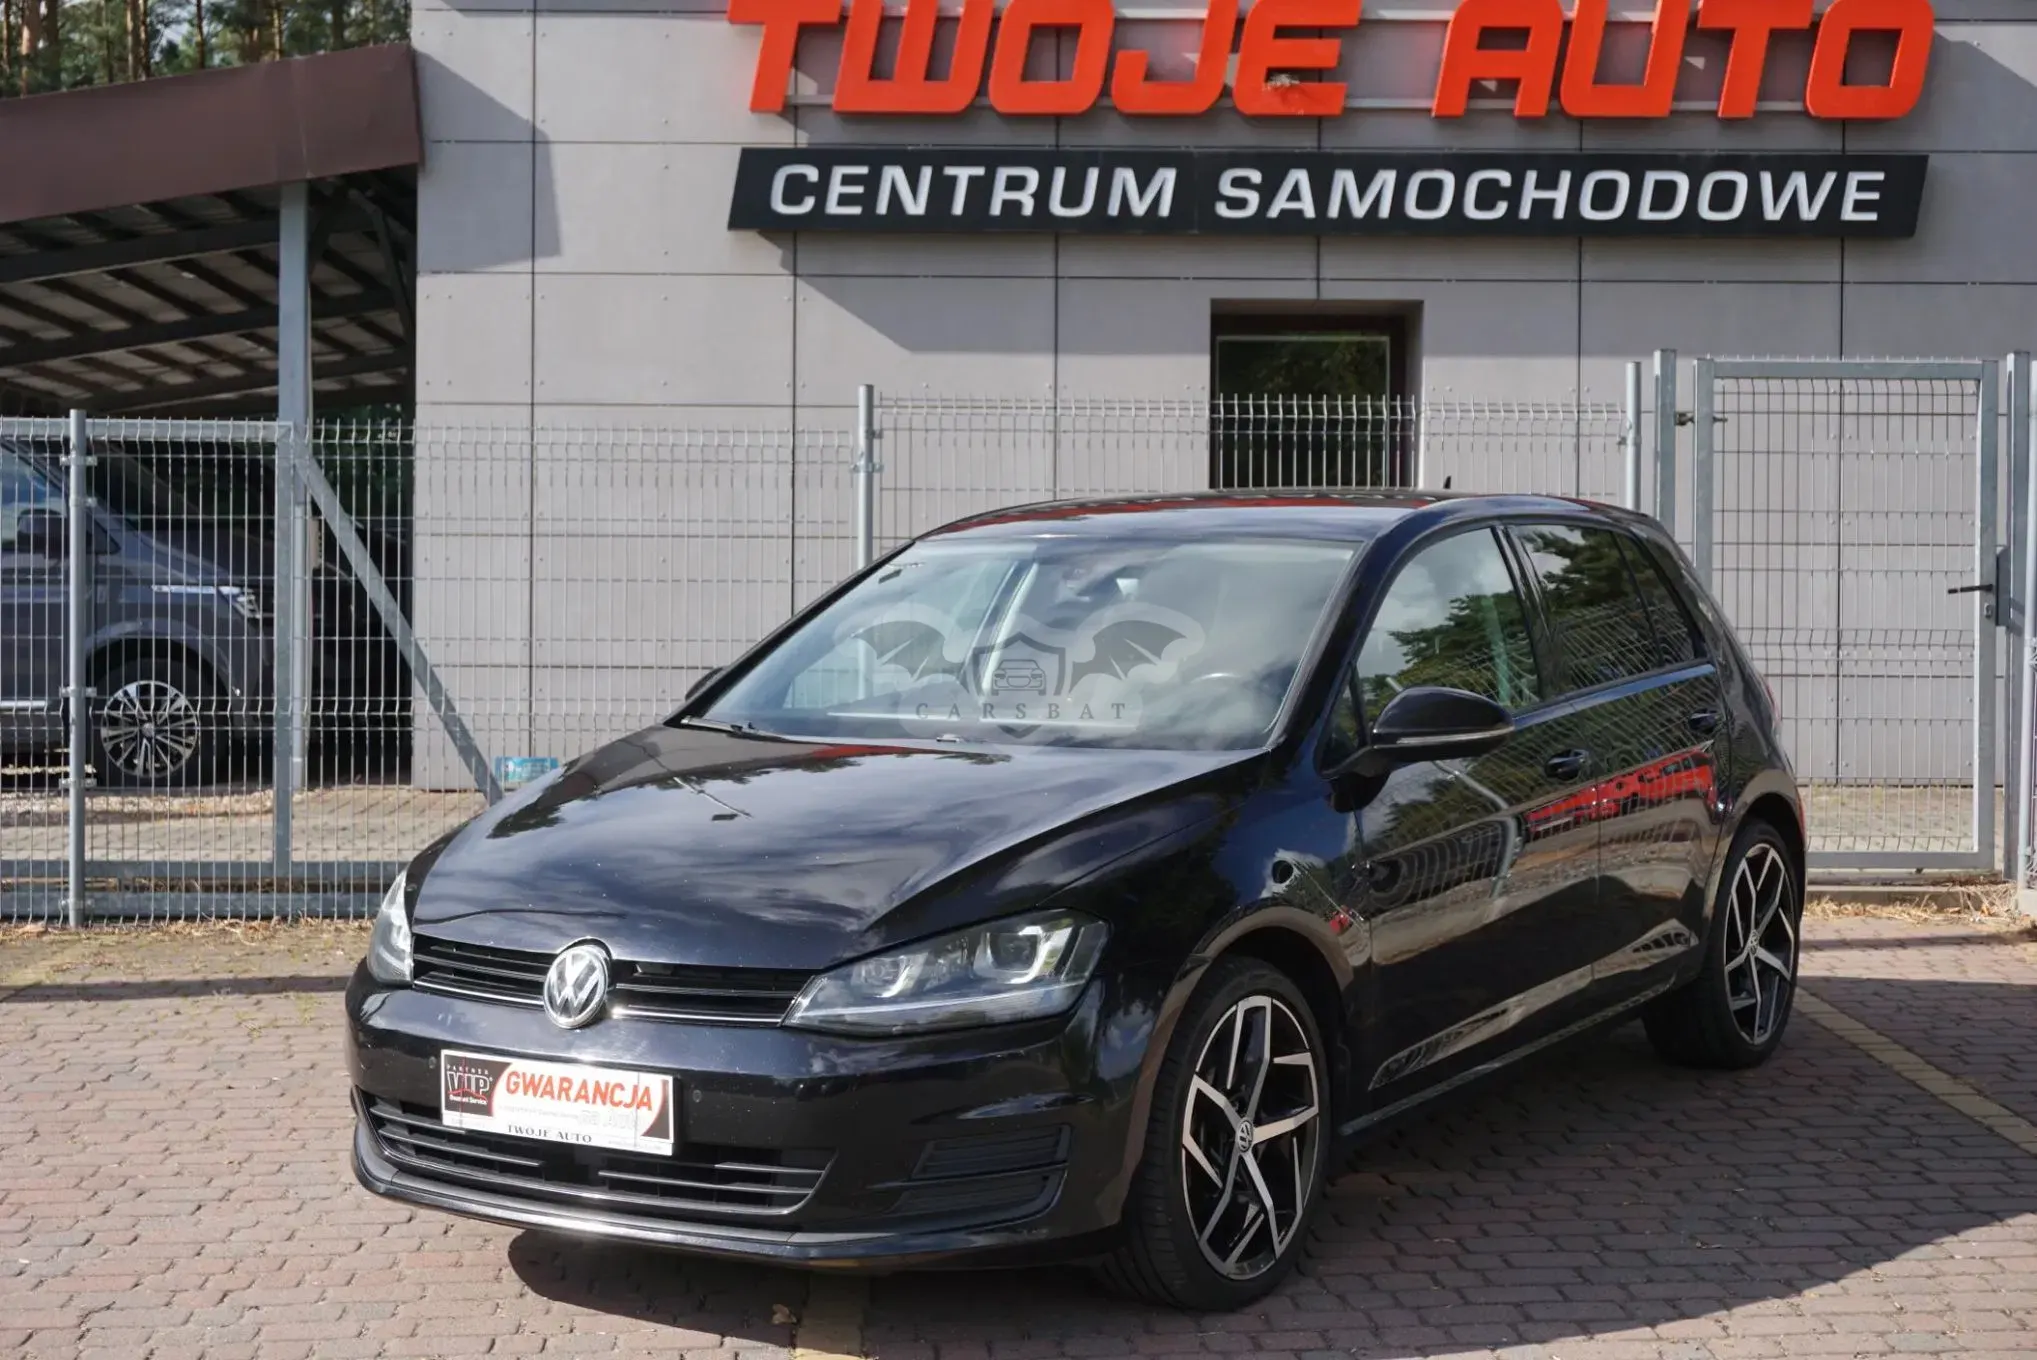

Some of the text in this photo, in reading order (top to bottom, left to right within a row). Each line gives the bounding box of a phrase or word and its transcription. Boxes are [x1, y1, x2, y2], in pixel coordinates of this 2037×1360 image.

[728, 0, 1935, 118] TWOJE AUTO
[769, 163, 1886, 222] CENTRUM SAMOCHODOWE
[446, 1070, 490, 1096] VIP
[505, 1071, 653, 1111] GWARANCJA
[507, 1124, 593, 1144] TWOJE AUTO
